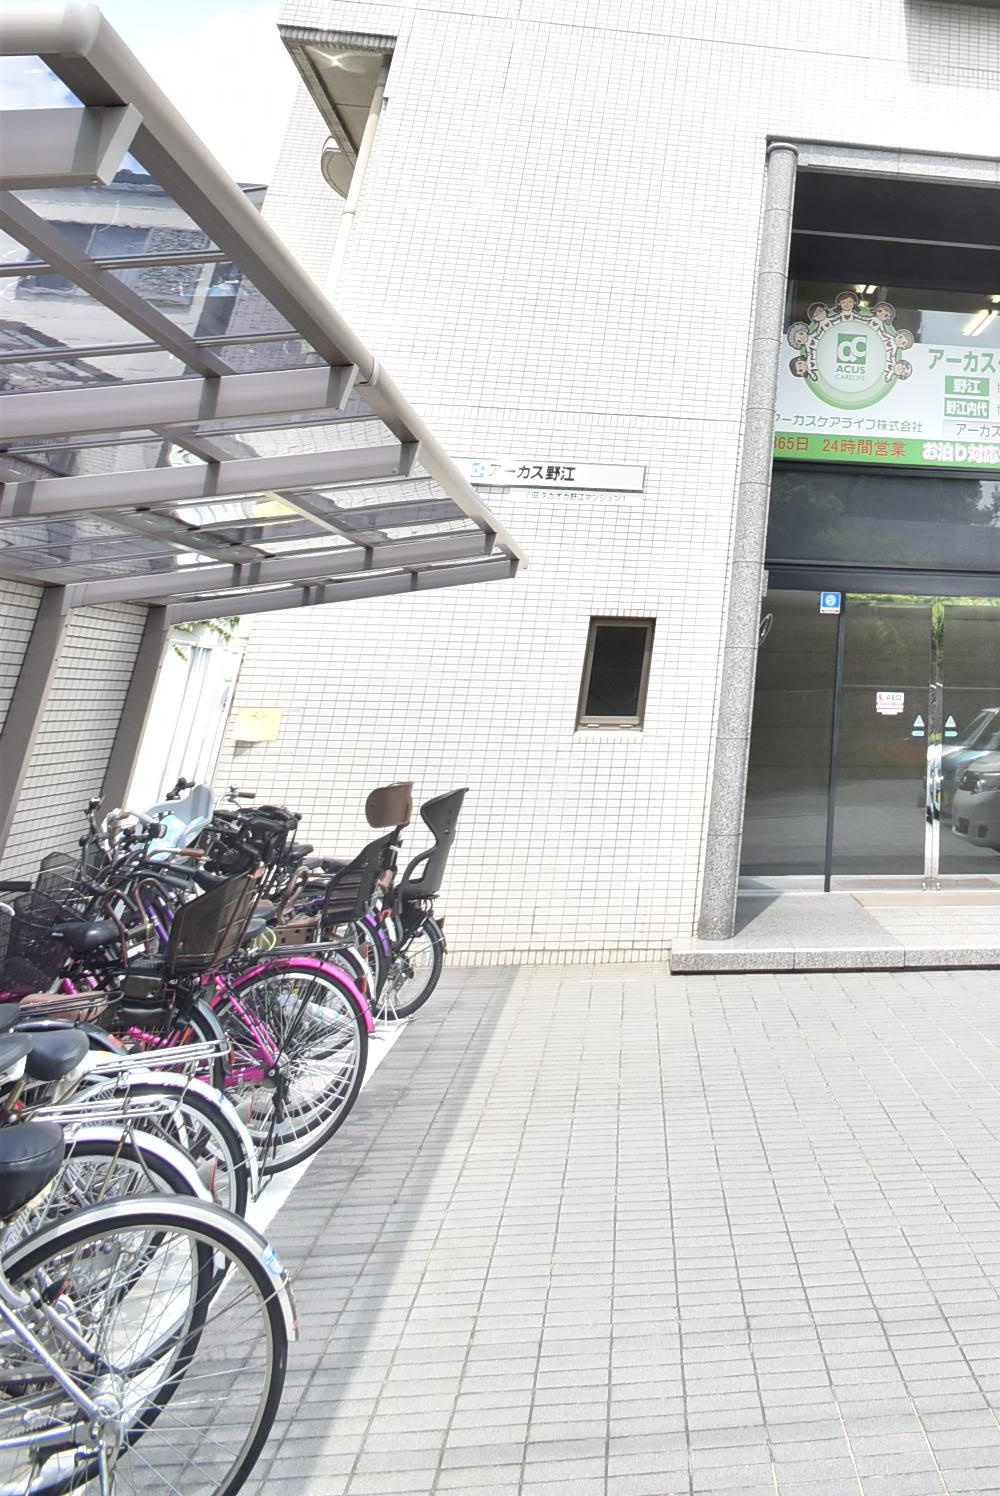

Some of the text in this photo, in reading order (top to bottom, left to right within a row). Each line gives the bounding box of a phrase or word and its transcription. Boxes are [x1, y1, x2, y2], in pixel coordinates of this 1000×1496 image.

[834, 374, 865, 382] CARELIFE
[835, 365, 866, 375] ACUS
[953, 377, 982, 395] 野江
[945, 400, 988, 418] 野江内代
[822, 438, 906, 457] 24時間営業
[488, 462, 576, 482] アーカス野江
